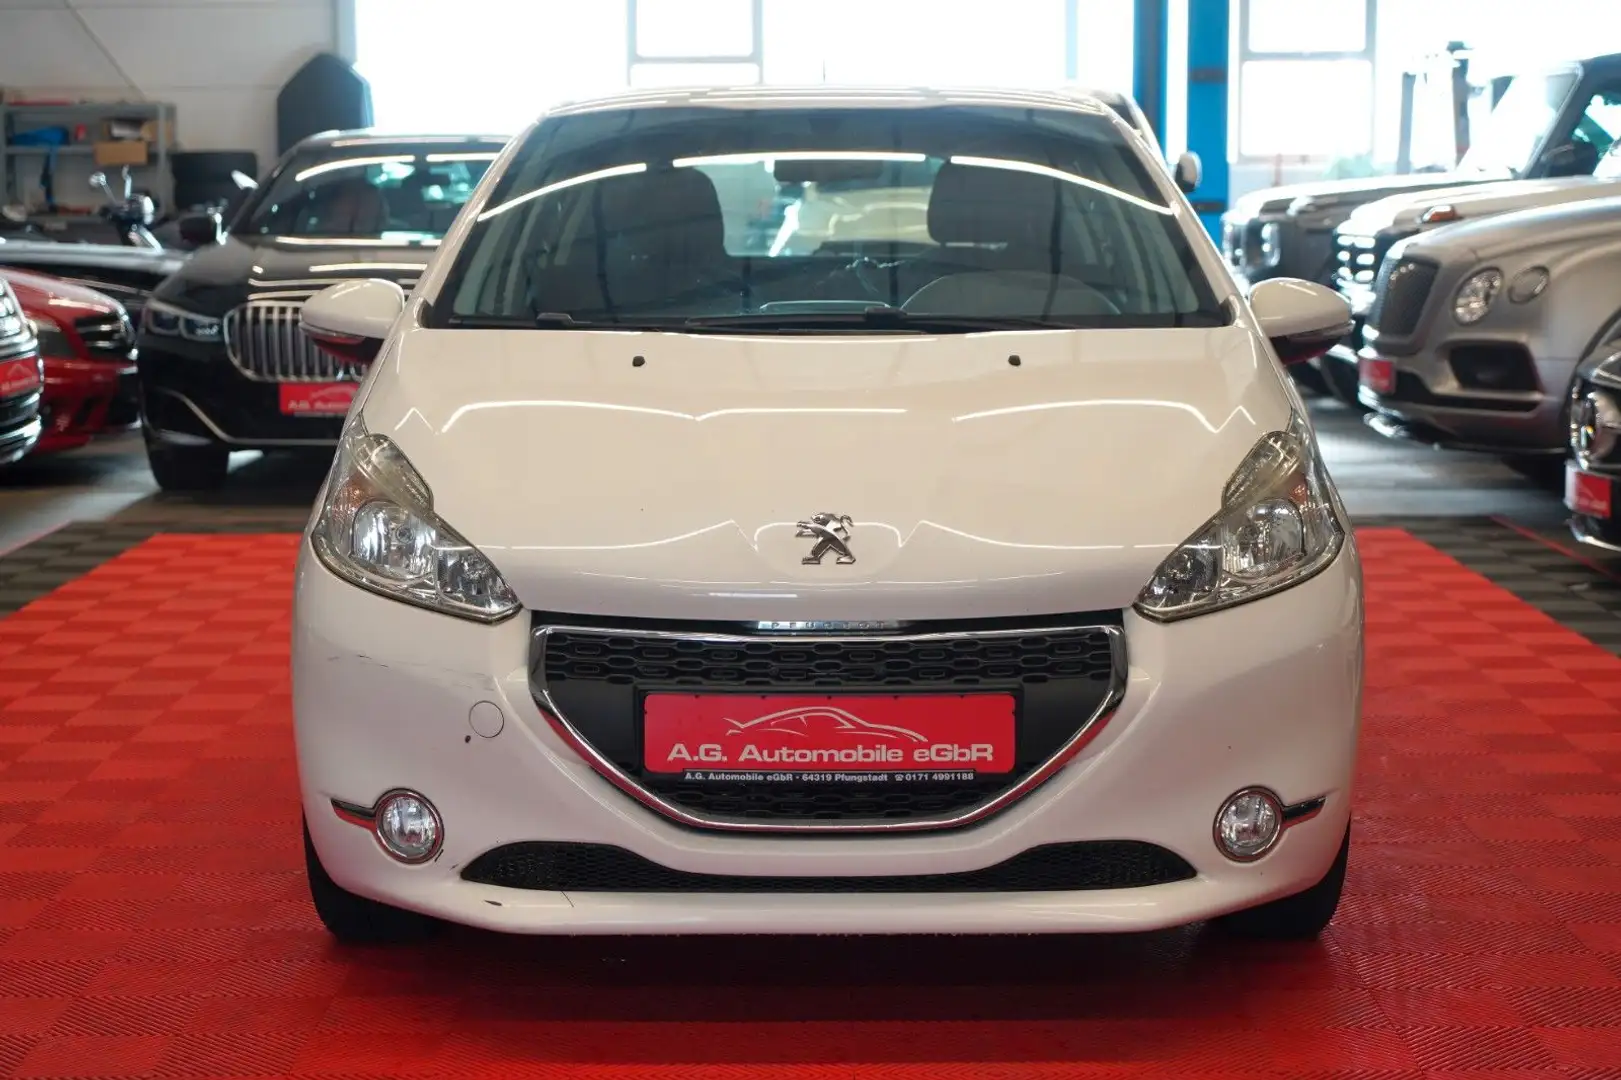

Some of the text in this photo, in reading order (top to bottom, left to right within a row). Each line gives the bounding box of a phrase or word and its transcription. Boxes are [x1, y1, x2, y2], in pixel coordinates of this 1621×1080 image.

[667, 743, 993, 762] A.G. Automobile eGbR
[684, 772, 974, 782] A.G. Automobile eGbR 64319 Pfungstadt 0171 4991188
